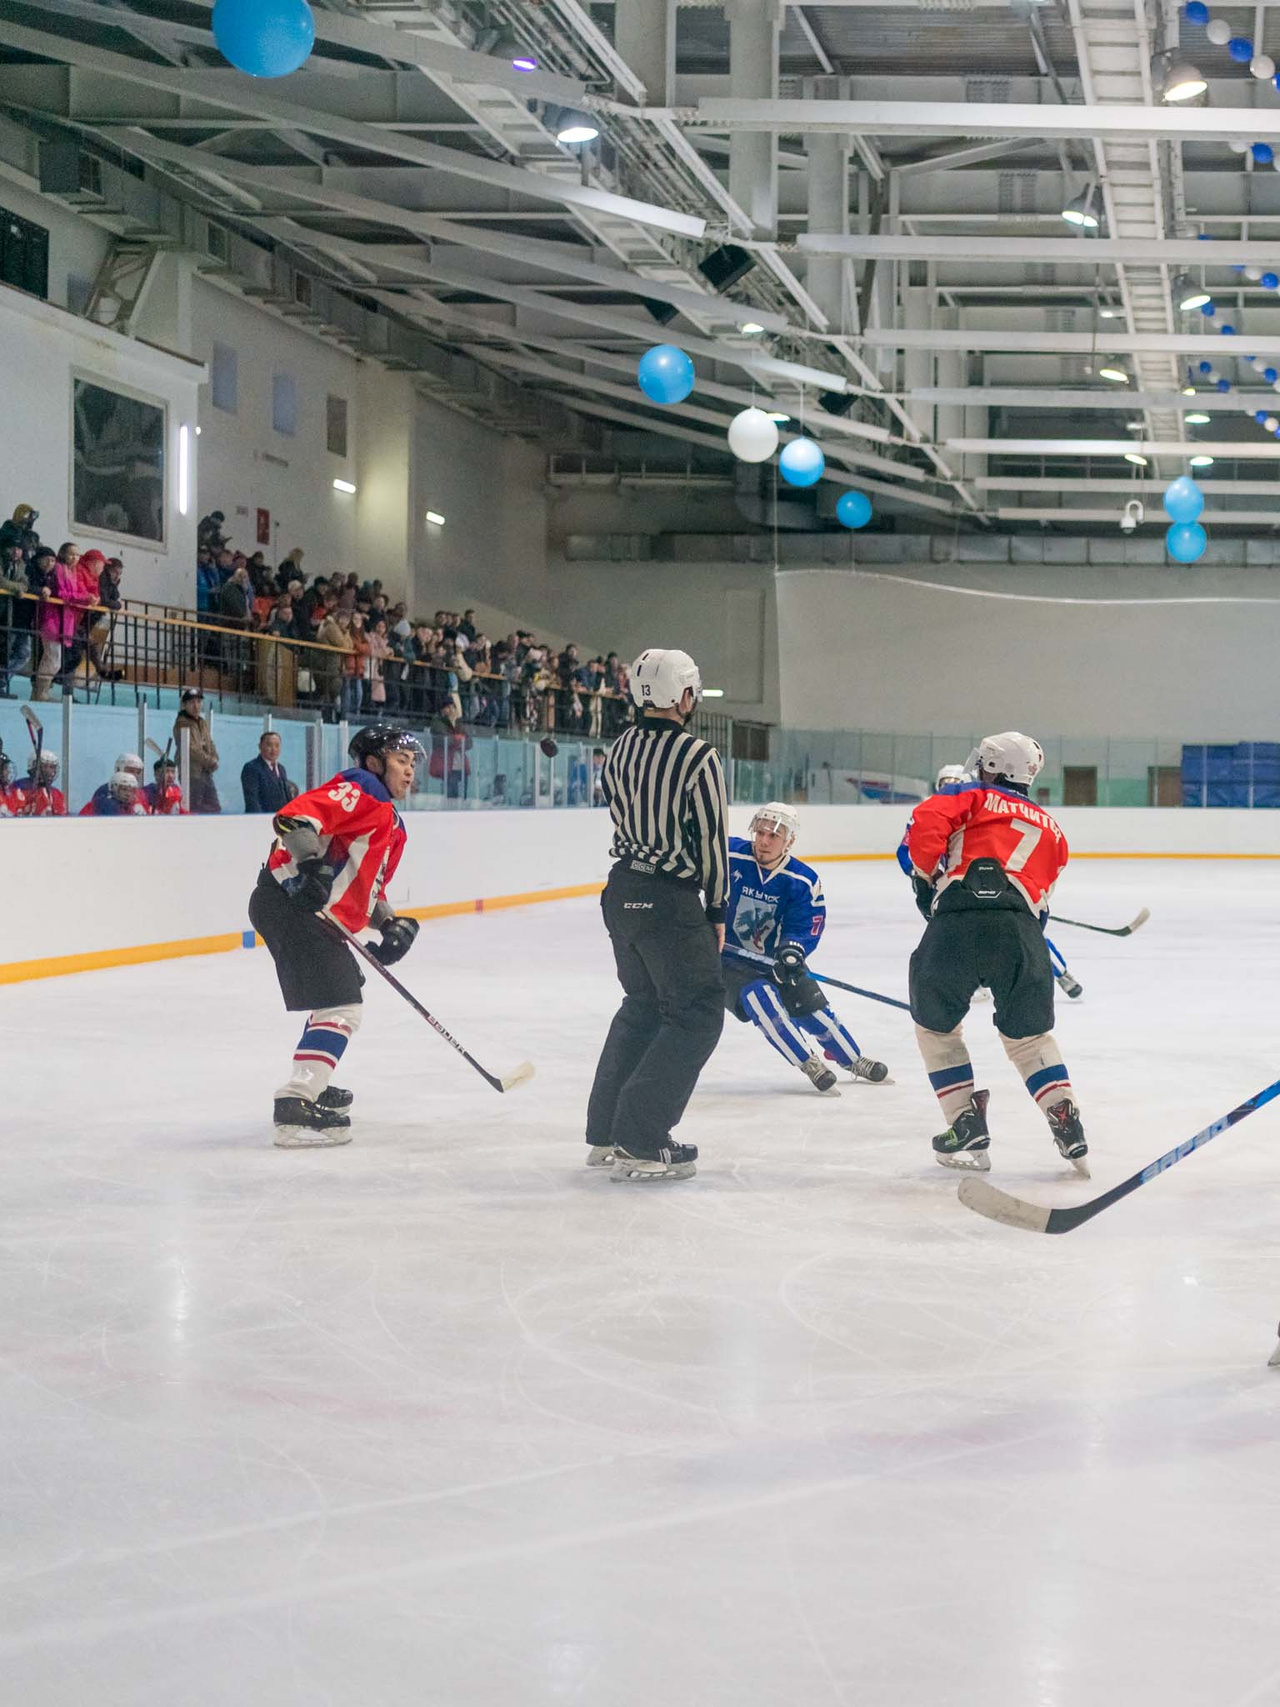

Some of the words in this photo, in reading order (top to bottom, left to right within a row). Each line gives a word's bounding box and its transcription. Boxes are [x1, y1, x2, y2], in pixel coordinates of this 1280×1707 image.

[641, 685, 651, 696] 13
[327, 781, 361, 812] 33
[1003, 817, 1043, 872] 7
